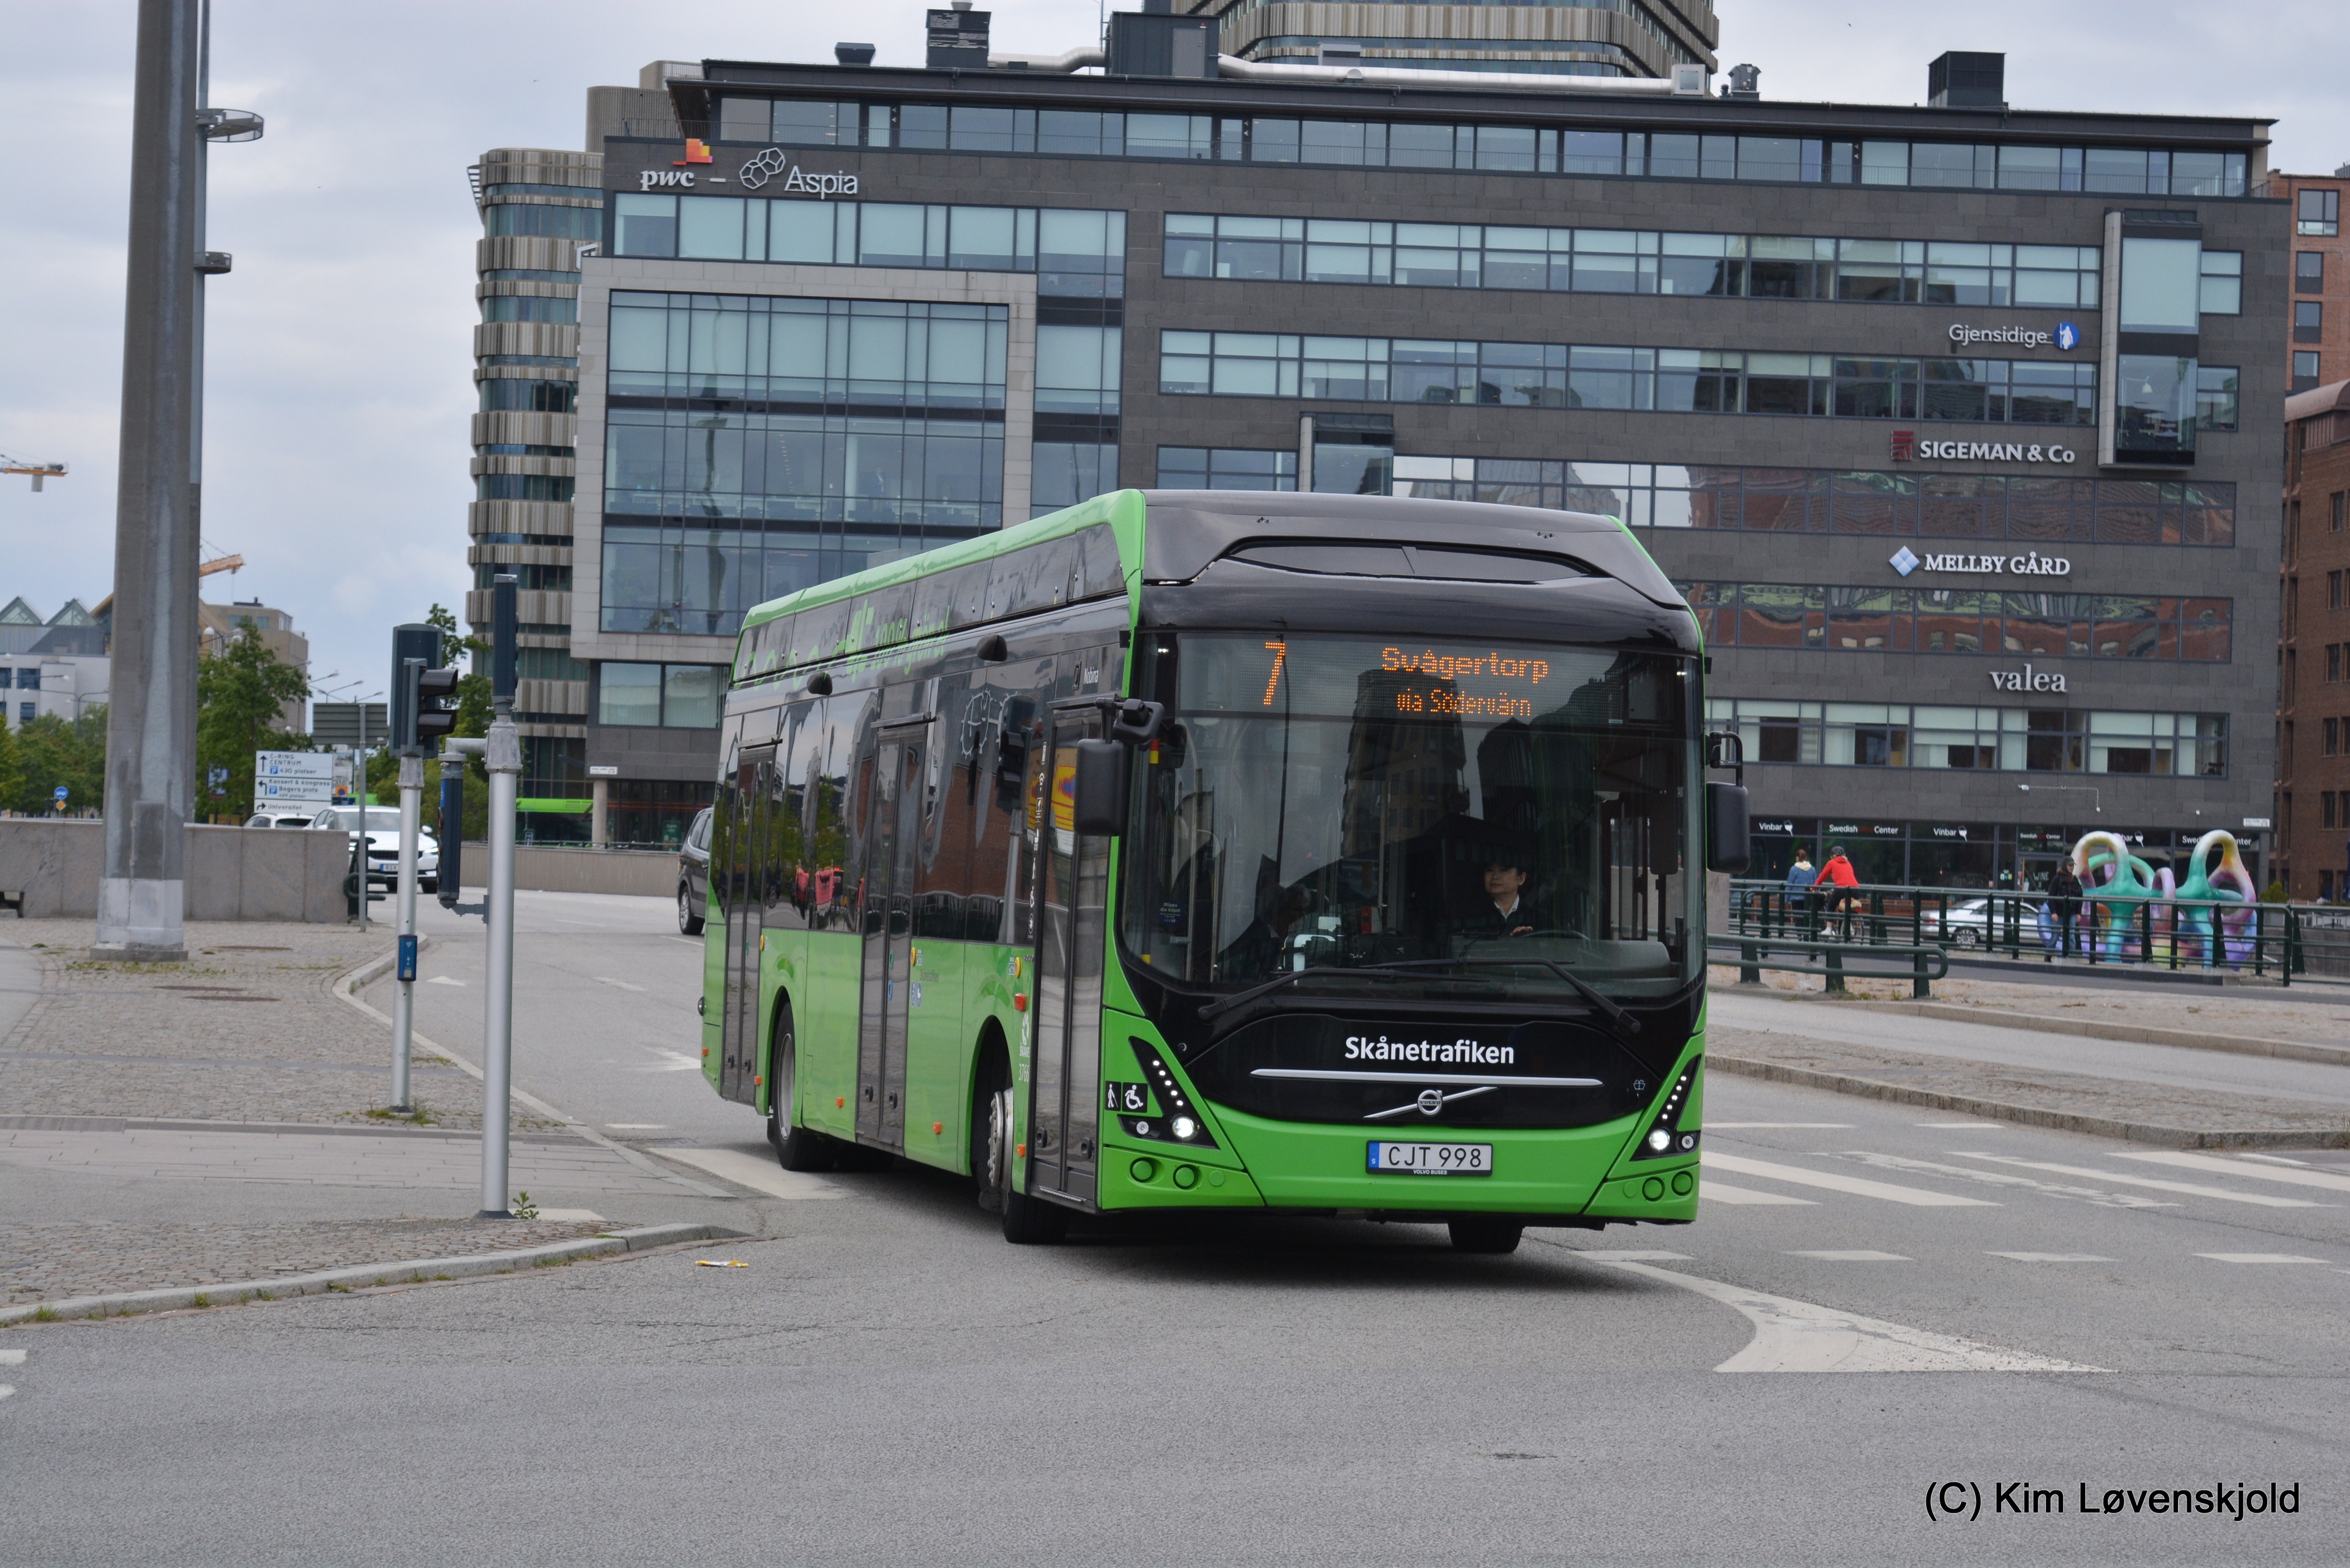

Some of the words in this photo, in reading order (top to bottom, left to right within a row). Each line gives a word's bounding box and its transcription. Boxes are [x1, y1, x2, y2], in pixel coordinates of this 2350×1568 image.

[640, 170, 694, 191] pwc
[785, 166, 857, 200] Aspia
[1949, 324, 2048, 348] Gjensidige
[1920, 440, 2022, 461] SIGEMAN
[2027, 444, 2043, 462] &
[2048, 445, 2075, 463] Co
[1924, 554, 2005, 573] MELLBY
[2010, 551, 2070, 575] GÅRD
[1083, 666, 1099, 684] Nobina
[1264, 642, 1285, 705] 7
[1382, 647, 1548, 684] Svågertorp
[1989, 663, 2067, 693] valea
[1397, 688, 1422, 712] via
[1431, 689, 1531, 716] Södervärn
[1759, 822, 1783, 831] Vinbar
[1829, 824, 1858, 834] Swedish
[1874, 826, 1898, 834] Center
[1933, 827, 1957, 837] Vinbar
[2032, 871, 2050, 881] WINE
[1345, 1036, 1514, 1064] Skånetrafiken
[1389, 1146, 1431, 1167] CJT
[1439, 1147, 1482, 1168] 998
